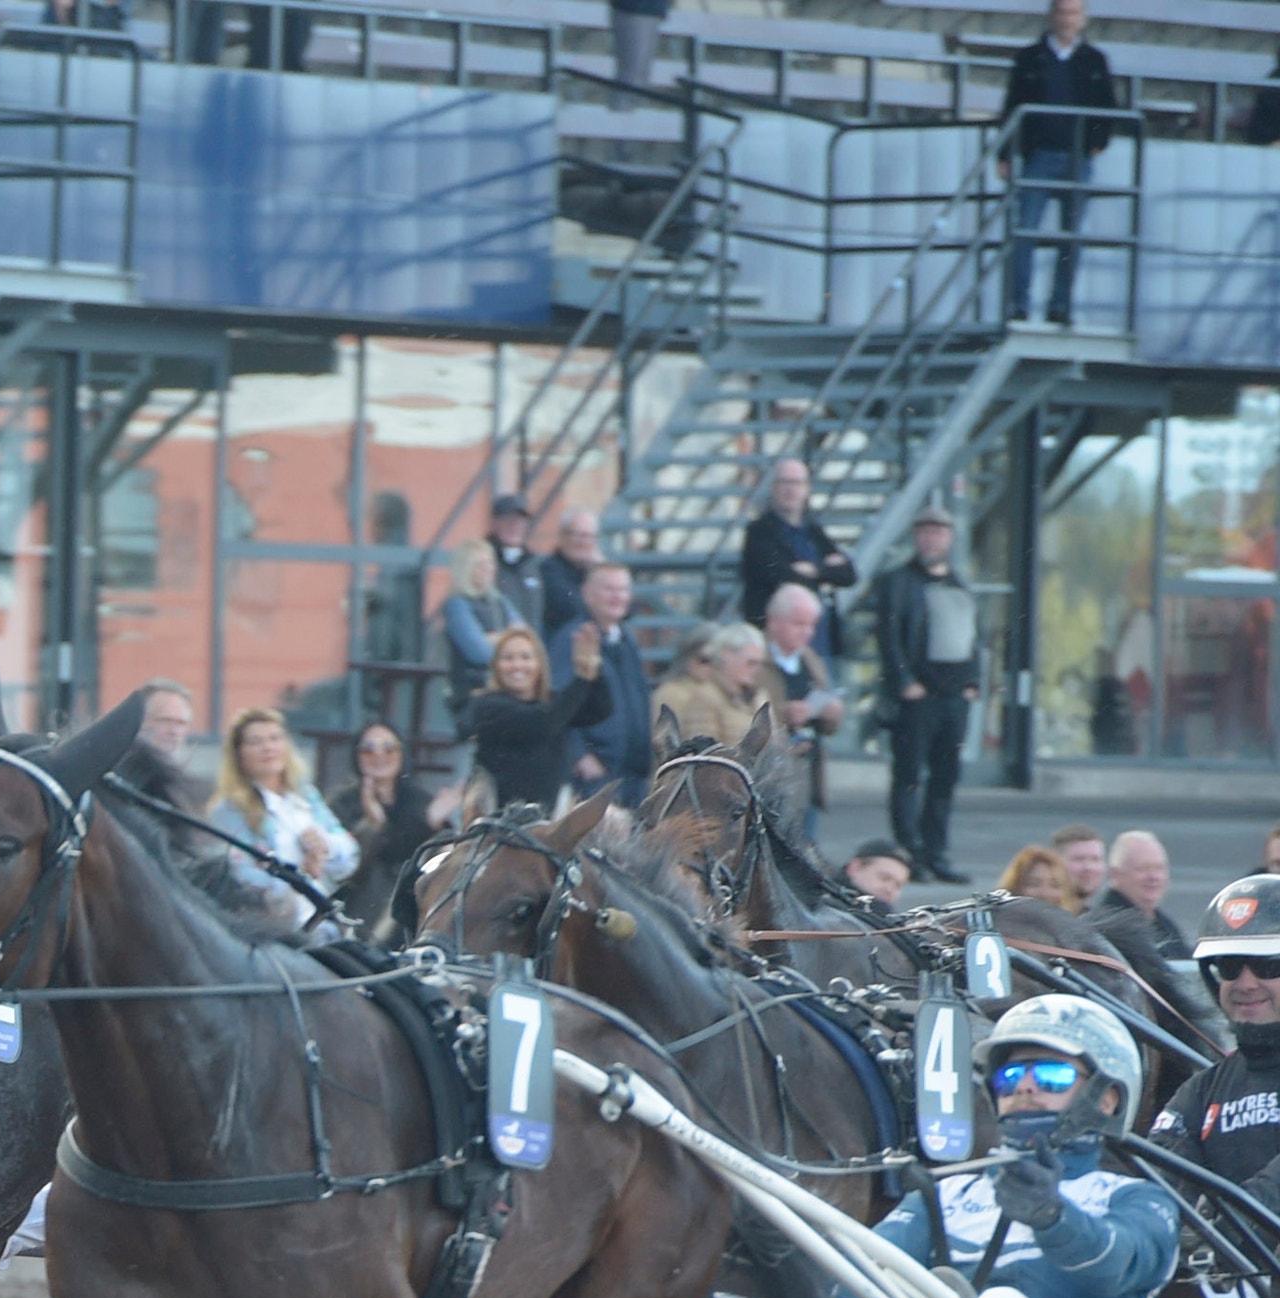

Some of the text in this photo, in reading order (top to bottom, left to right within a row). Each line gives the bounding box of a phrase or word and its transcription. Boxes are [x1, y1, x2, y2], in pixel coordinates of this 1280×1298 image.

[502, 993, 542, 1113] 7
[924, 1008, 958, 1113] 4
[1222, 1092, 1278, 1116] HYRES
